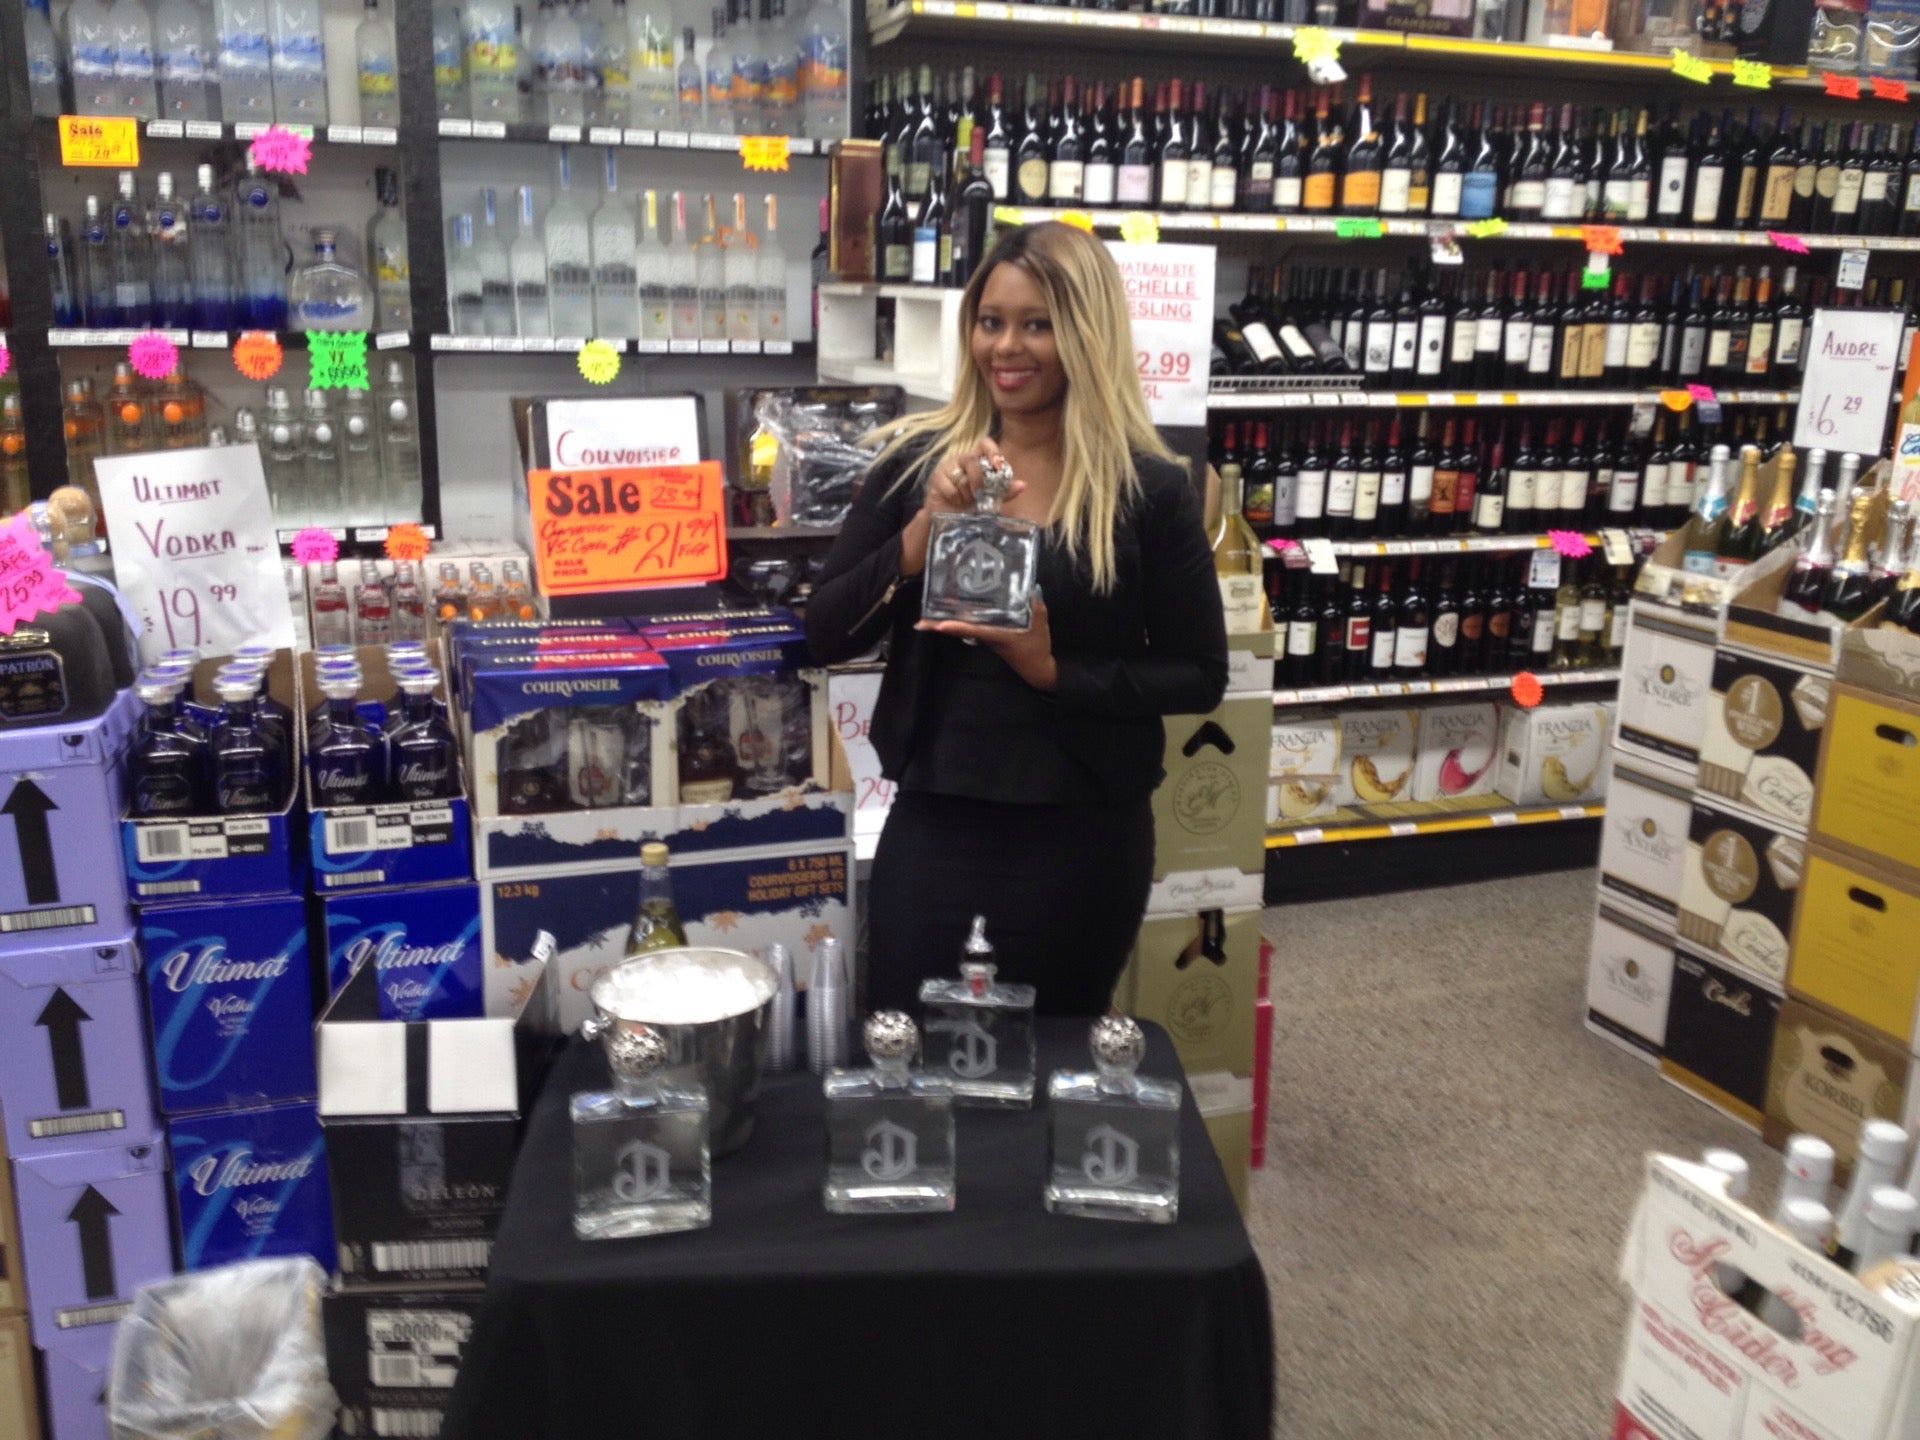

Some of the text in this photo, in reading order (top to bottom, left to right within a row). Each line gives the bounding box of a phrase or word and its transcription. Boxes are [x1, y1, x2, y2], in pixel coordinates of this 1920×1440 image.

[69, 121, 104, 137] Sale
[1128, 301, 1193, 318] ESLING
[1822, 330, 1878, 357] ANDRE
[1843, 396, 1862, 412] 29
[132, 475, 222, 502] ULTIMAT
[546, 475, 641, 517] Sale
[135, 518, 237, 559] VODKA
[209, 584, 237, 602] 99
[696, 648, 784, 667] COURVOISIER
[522, 677, 622, 698] COURVOISIER
[1343, 717, 1401, 740] FRANZIA
[1430, 710, 1486, 733] FRANZIA
[1537, 718, 1593, 740] FRANZIA
[496, 884, 522, 899] 12.3
[747, 880, 844, 902] HOLIDAY GIFT SETS
[344, 930, 465, 977] Ultimat
[161, 945, 290, 993] Ultimat
[384, 979, 433, 1003] Vodka
[206, 994, 257, 1018] Vodka
[189, 1150, 314, 1197] Ultimat
